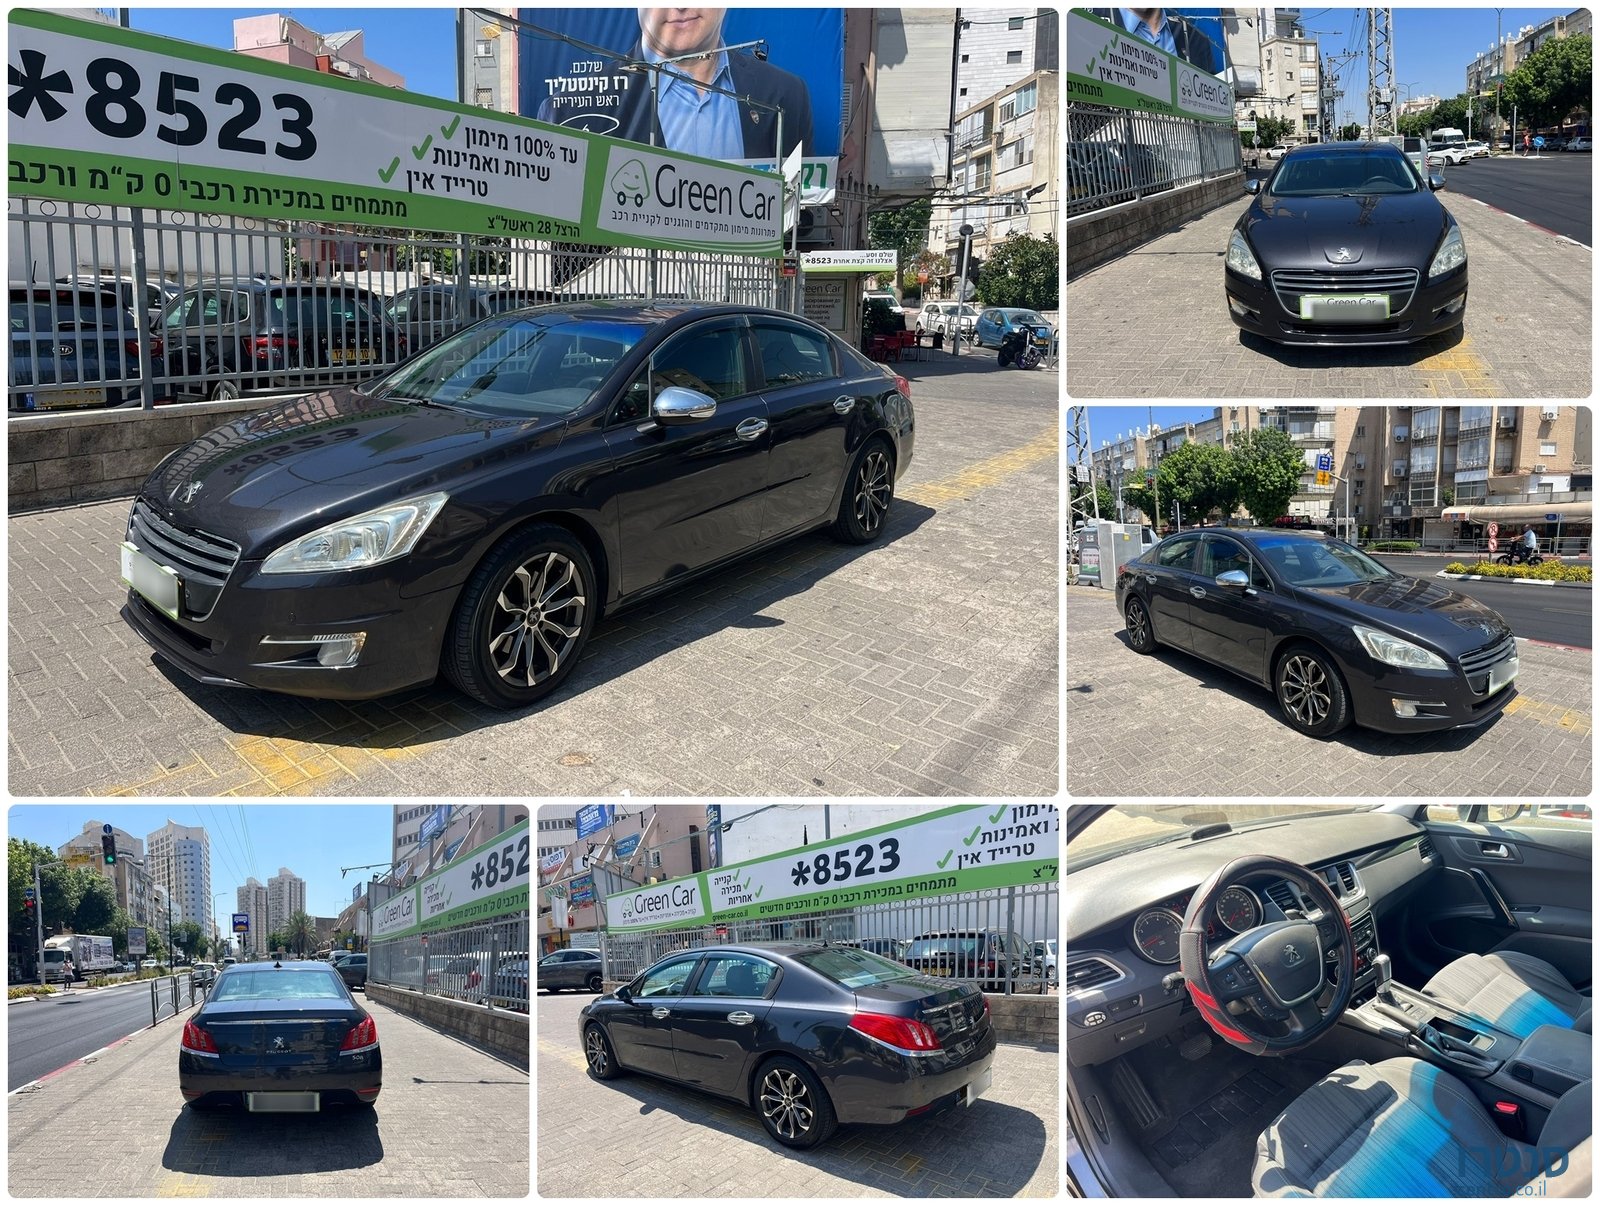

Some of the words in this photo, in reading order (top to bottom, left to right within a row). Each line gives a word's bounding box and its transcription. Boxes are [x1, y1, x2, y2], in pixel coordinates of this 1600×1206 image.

[1120, 41, 1140, 59] מימון
[1141, 49, 1159, 67] 100%
[570, 60, 603, 74] שלכם,
[1108, 52, 1139, 74] ואמינות
[1098, 66, 1113, 82] אין
[1114, 71, 1136, 87] טרייד
[1139, 64, 1158, 80] שירות
[544, 76, 609, 96] קינסטליך
[613, 75, 629, 90] רז
[1067, 81, 1103, 98] מתמחים
[1193, 73, 1218, 103] Green
[553, 95, 592, 109] העירייה
[596, 94, 620, 107] ראש
[464, 126, 509, 150] מימון
[514, 135, 556, 160] 100%
[560, 146, 578, 164] עד
[432, 146, 500, 174] ואמינות
[504, 159, 551, 182] שירות
[154, 172, 171, 197] 0
[406, 169, 435, 193] אין
[440, 174, 489, 197] טרייד
[179, 178, 236, 203] רכבי
[243, 185, 325, 211] במכירת
[655, 163, 733, 217] Green
[739, 180, 776, 222] Car
[331, 194, 408, 217] מתמחים
[611, 209, 629, 221] רכב
[632, 212, 661, 227] לקניית
[537, 220, 552, 235] 28
[554, 221, 581, 238] הרצל
[980, 820, 1049, 845] ואמינות
[987, 842, 1035, 861] טרייד
[957, 851, 981, 870] אין
[714, 875, 732, 885] קנייה
[906, 877, 957, 894] מתמחים
[721, 884, 742, 895] מכירה
[840, 892, 861, 904] רכבי
[863, 885, 903, 900] במכירת
[401, 896, 415, 917] Car
[503, 895, 519, 908] רכבי
[634, 893, 670, 914] Green
[672, 885, 696, 907] Car
[728, 894, 753, 905] אחריות
[760, 902, 784, 914] חדשים
[786, 900, 811, 911] ורכבים
[832, 894, 838, 905] 0
